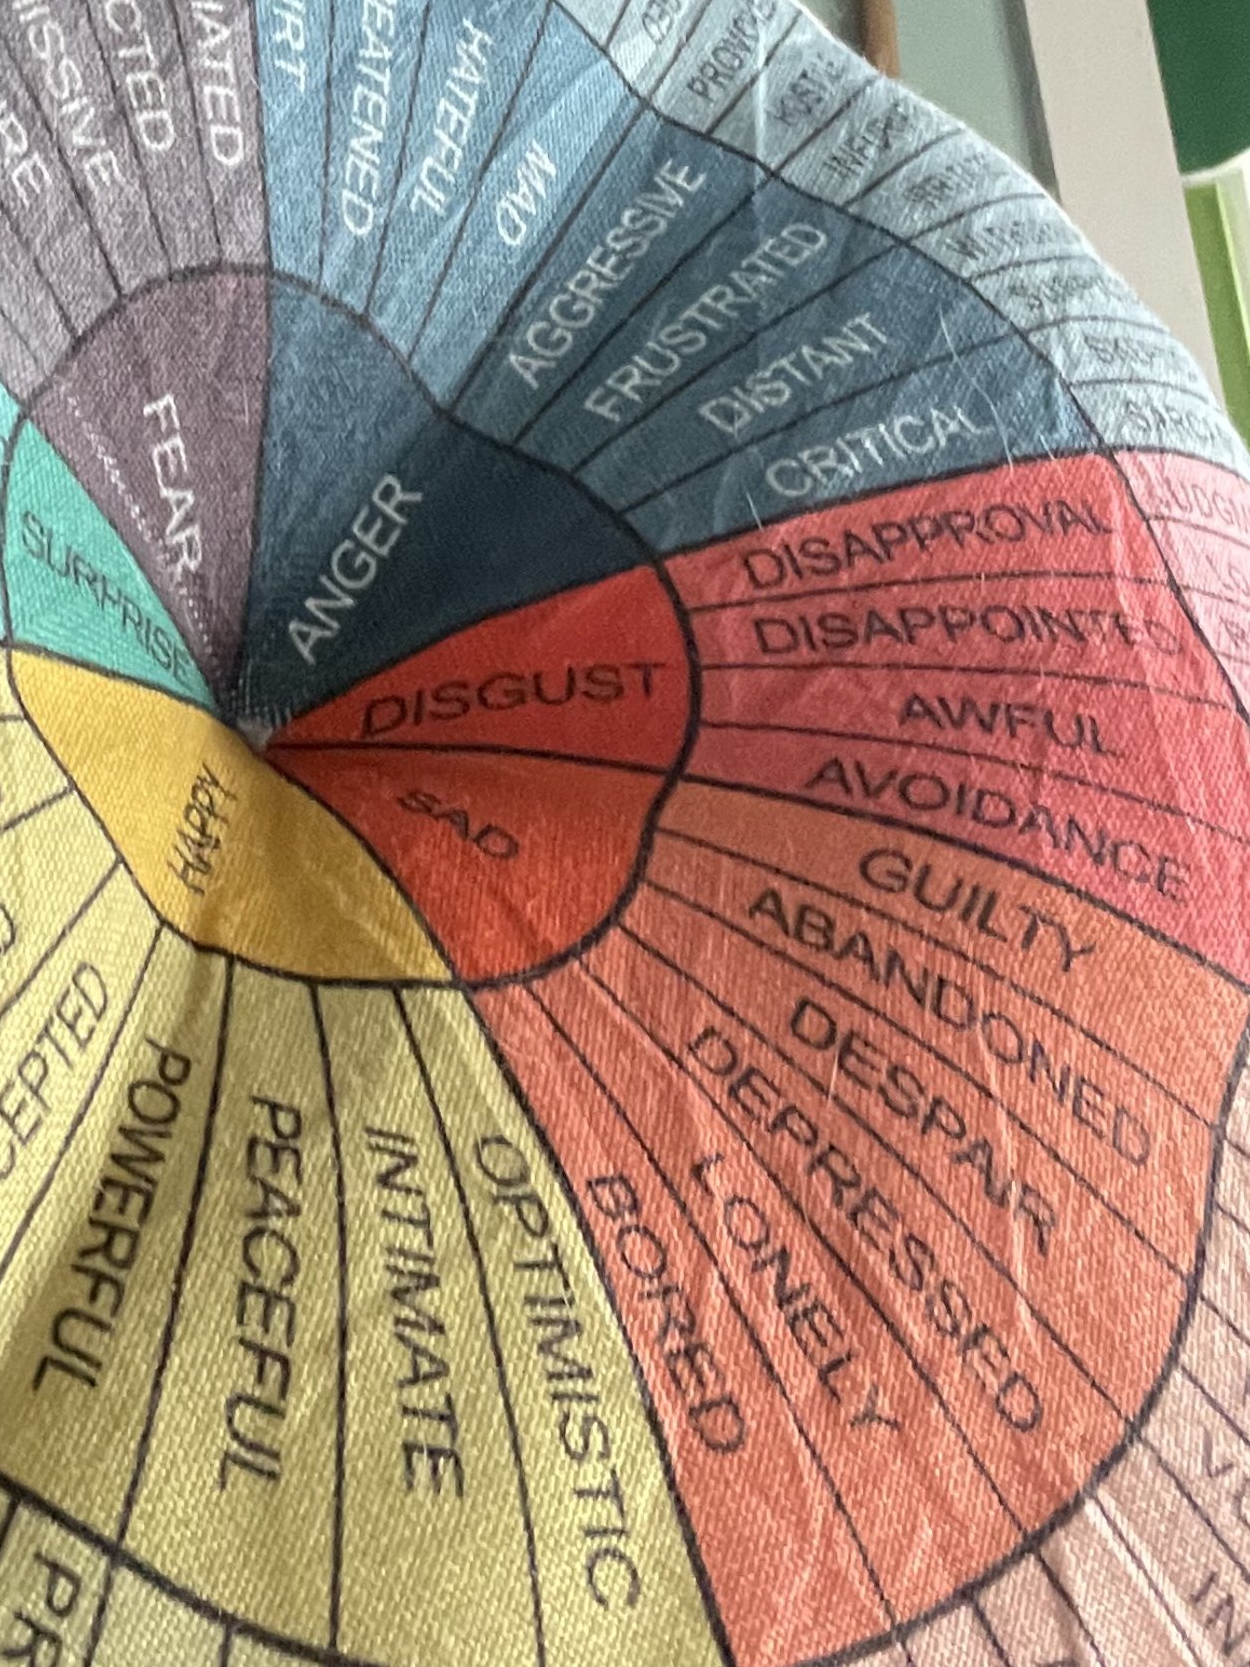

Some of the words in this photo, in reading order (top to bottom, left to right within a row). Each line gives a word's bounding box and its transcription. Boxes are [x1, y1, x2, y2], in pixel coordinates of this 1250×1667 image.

[411, 17, 497, 217] HATEFUL
[496, 139, 558, 246] MAD
[507, 159, 708, 390] AGGRESSIVE
[584, 221, 827, 423] FRUSTRATED
[697, 311, 891, 436] DISTANT
[765, 406, 997, 498] CRITICAL
[144, 394, 203, 584] FEAR
[288, 474, 423, 664] ANGER
[744, 499, 1114, 590] DISAPPROVAL
[21, 510, 194, 679] SURPRISE
[360, 662, 666, 738] DISGUST
[898, 693, 1120, 757] AWFUL
[168, 763, 238, 895] HAPPY
[397, 788, 520, 859] SAD
[805, 758, 1192, 909] AVOIDANCE
[859, 848, 1095, 972] GUILTY
[750, 886, 1150, 1167] ABANDONED
[32, 1038, 192, 1392] POWERFUL
[789, 997, 1059, 1256] DESPAIR
[218, 1095, 303, 1491] PEACEFUL
[365, 1125, 464, 1499] INTIMATE
[587, 1174, 745, 1454] BORED
[689, 1026, 1042, 1432] DEPRESSED
[693, 1152, 900, 1430] LONELY
[475, 1136, 642, 1610] OPTIMISTIC
